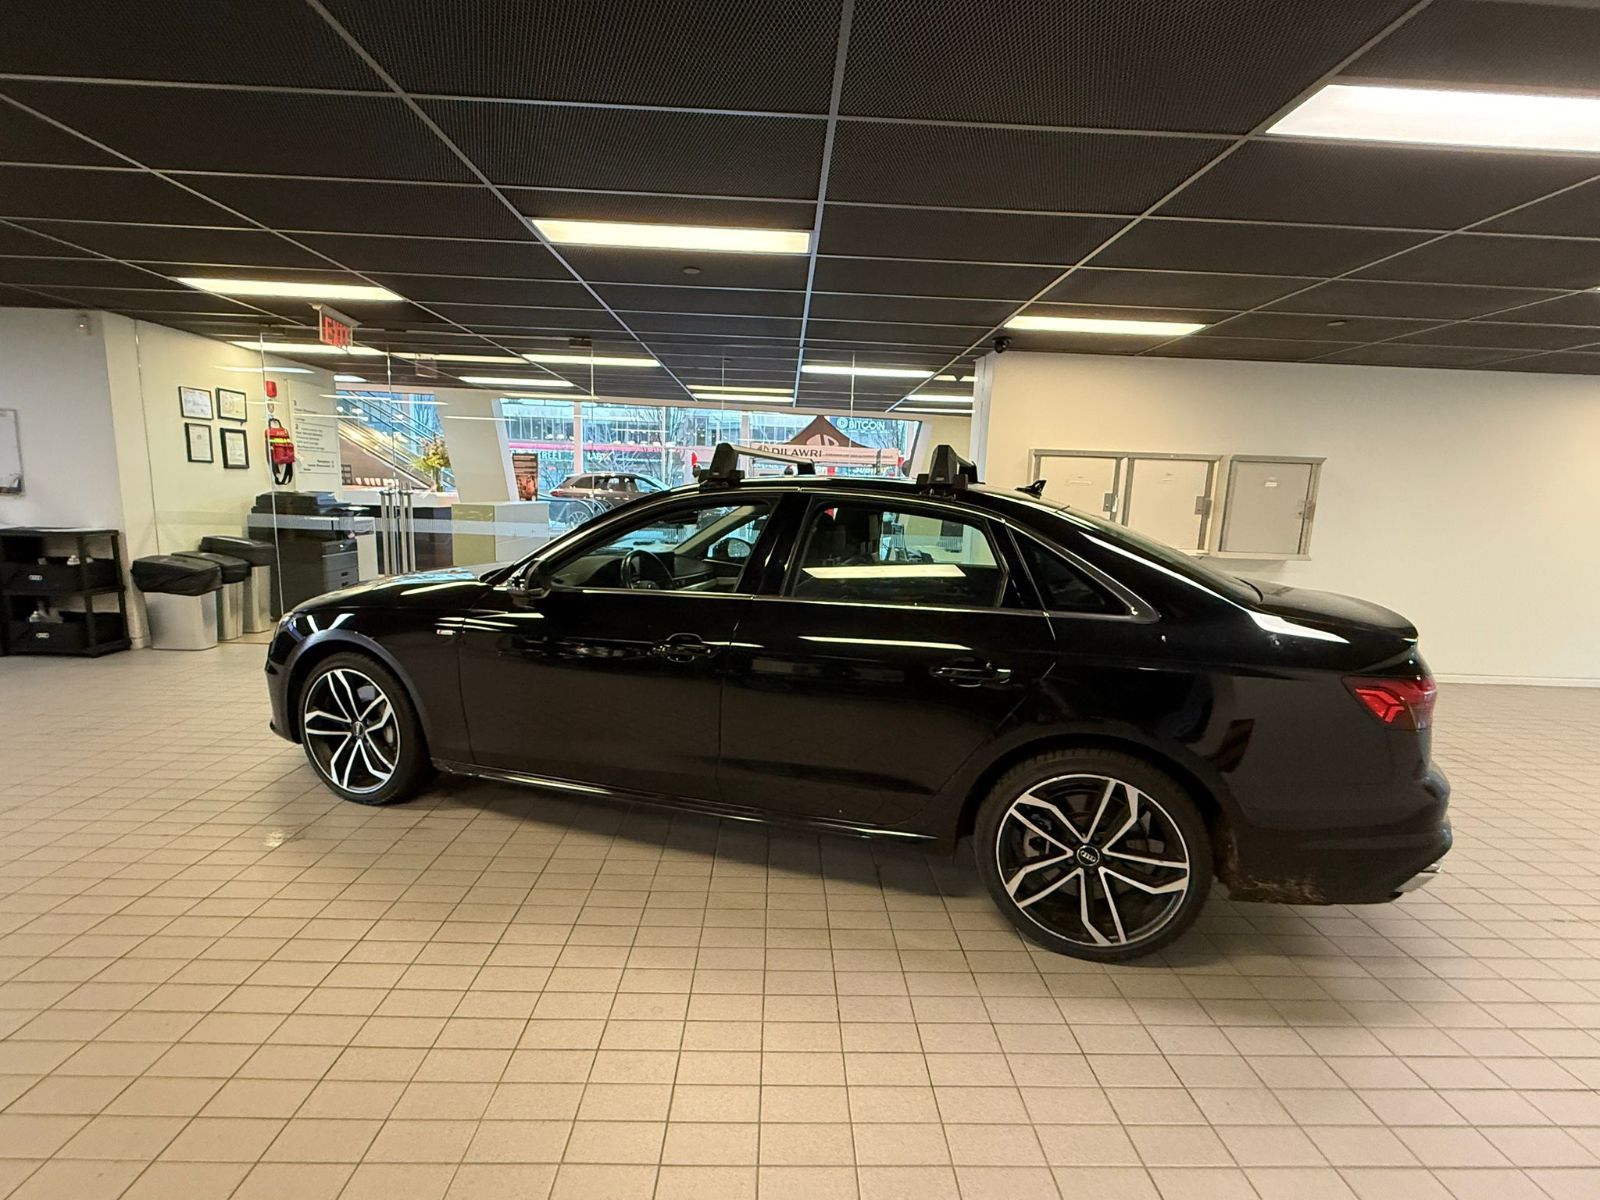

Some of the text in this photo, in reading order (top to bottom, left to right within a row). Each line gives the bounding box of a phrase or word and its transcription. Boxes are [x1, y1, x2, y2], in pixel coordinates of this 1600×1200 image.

[325, 316, 350, 347] EXIT
[849, 421, 885, 430] BITCOIN
[772, 447, 822, 457] DILAWRI
